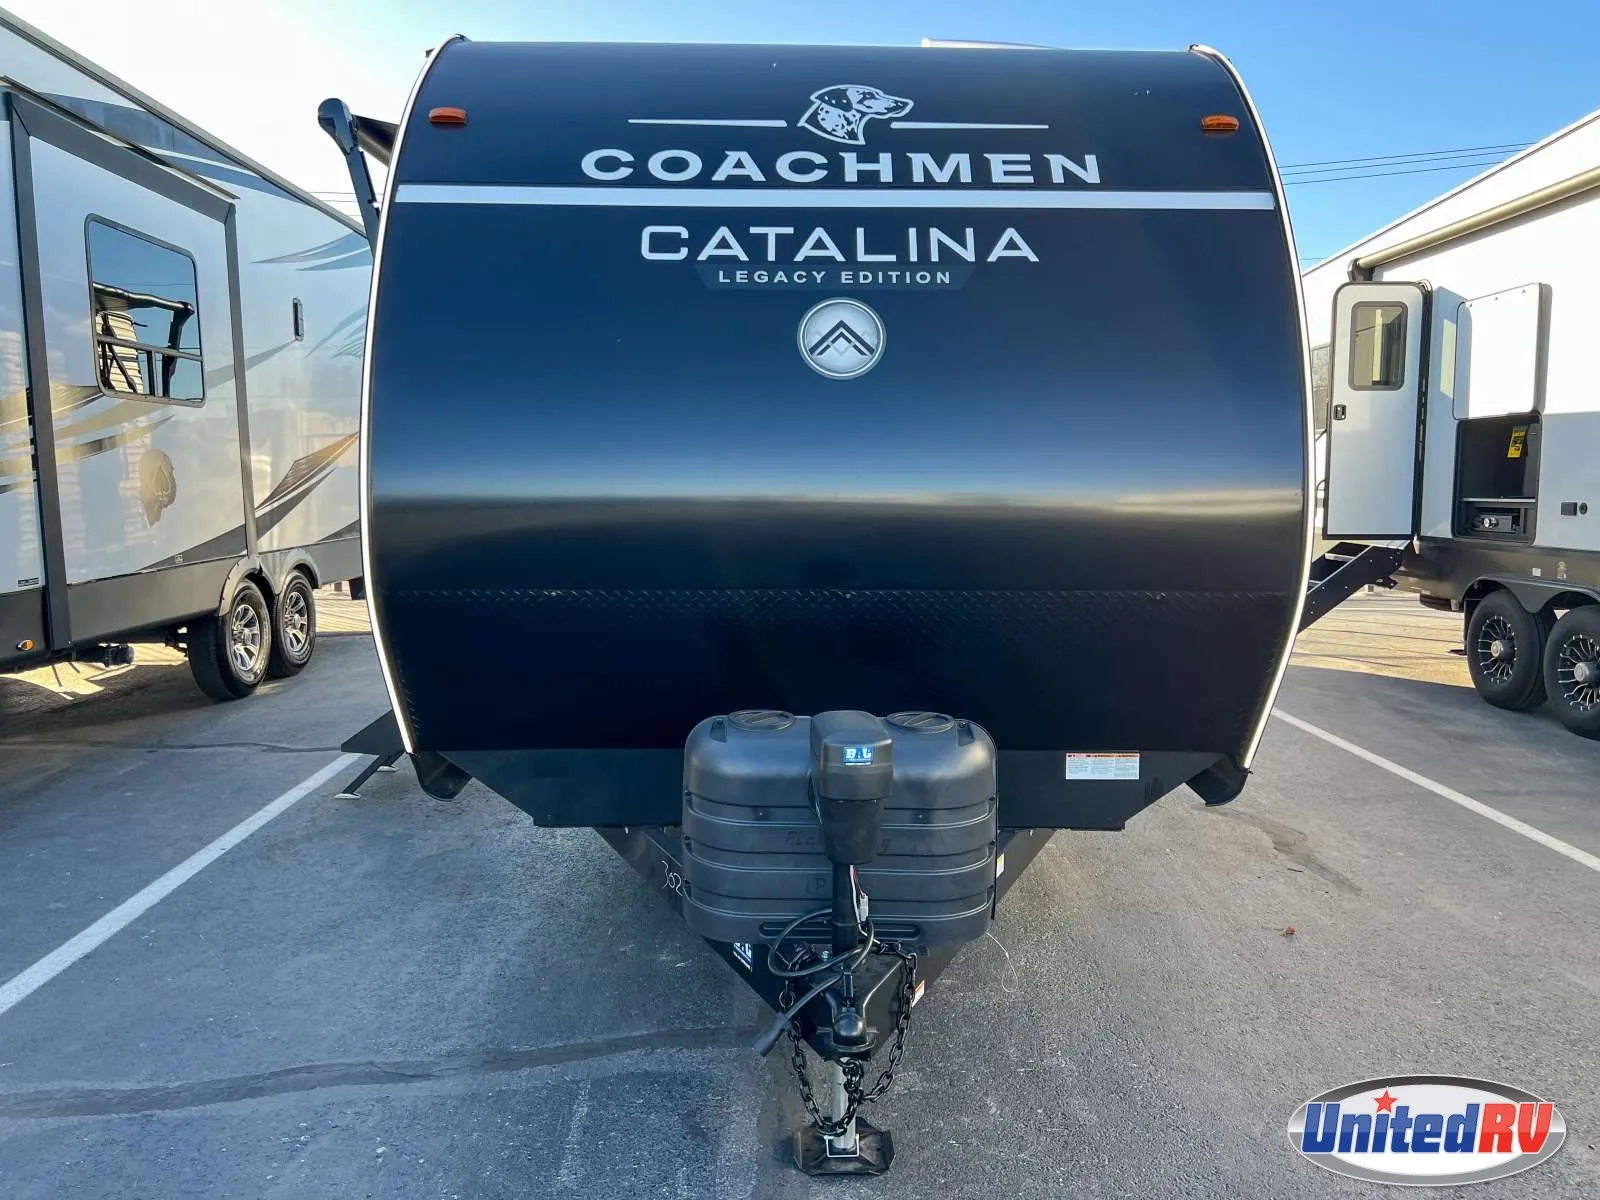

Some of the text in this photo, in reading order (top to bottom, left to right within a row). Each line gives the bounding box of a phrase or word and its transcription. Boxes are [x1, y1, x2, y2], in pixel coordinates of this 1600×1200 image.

[580, 147, 1102, 184] COACHMEN
[640, 224, 1041, 263] CATALINA
[717, 269, 951, 285] LEGACY EDITION
